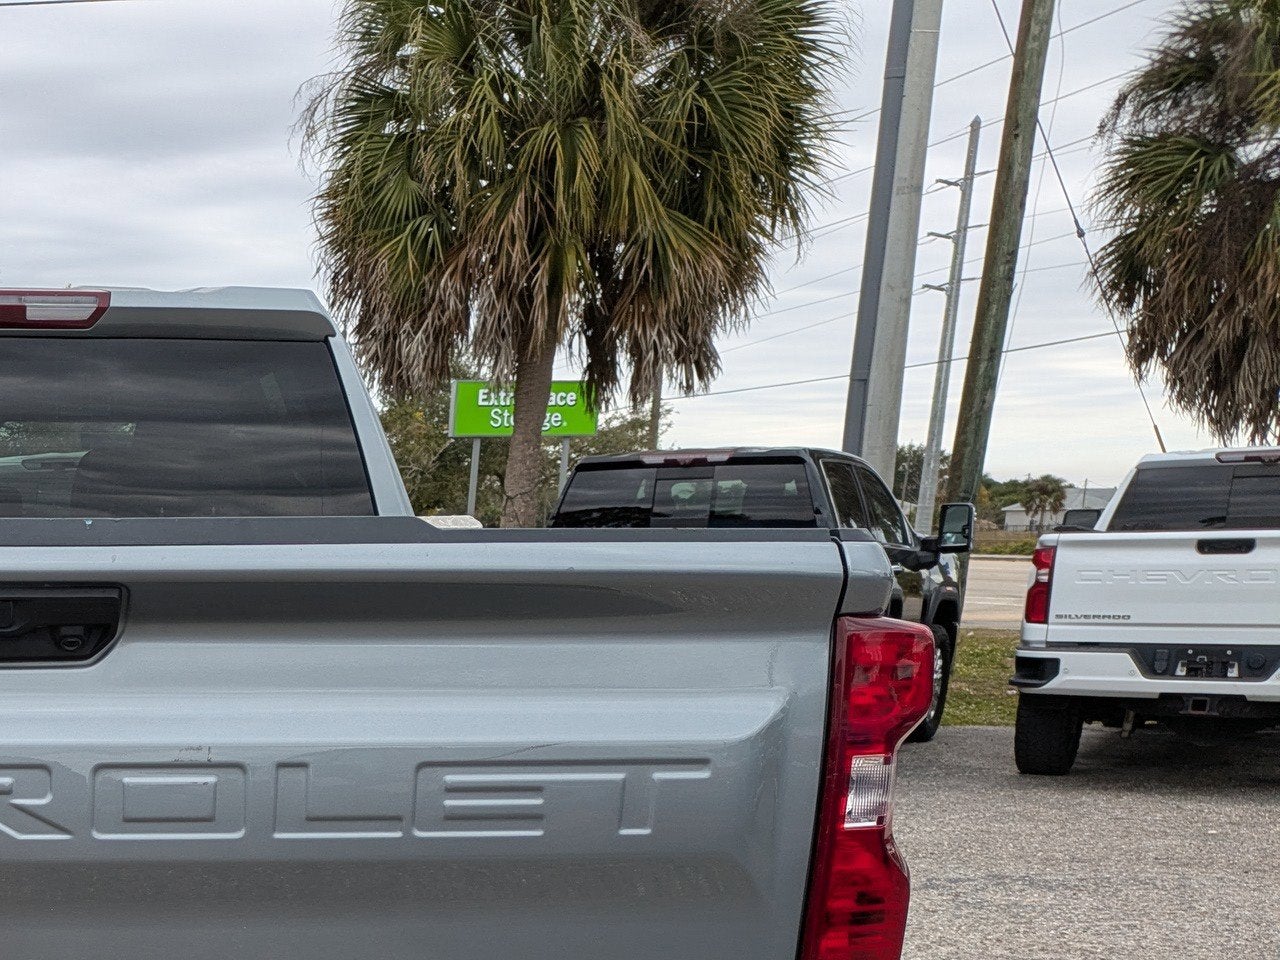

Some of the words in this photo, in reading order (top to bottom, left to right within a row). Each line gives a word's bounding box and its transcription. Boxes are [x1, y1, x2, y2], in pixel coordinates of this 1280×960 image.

[478, 388, 517, 406] Extr
[490, 408, 568, 431] Stge.
[1075, 569, 1279, 584] CHEVRO
